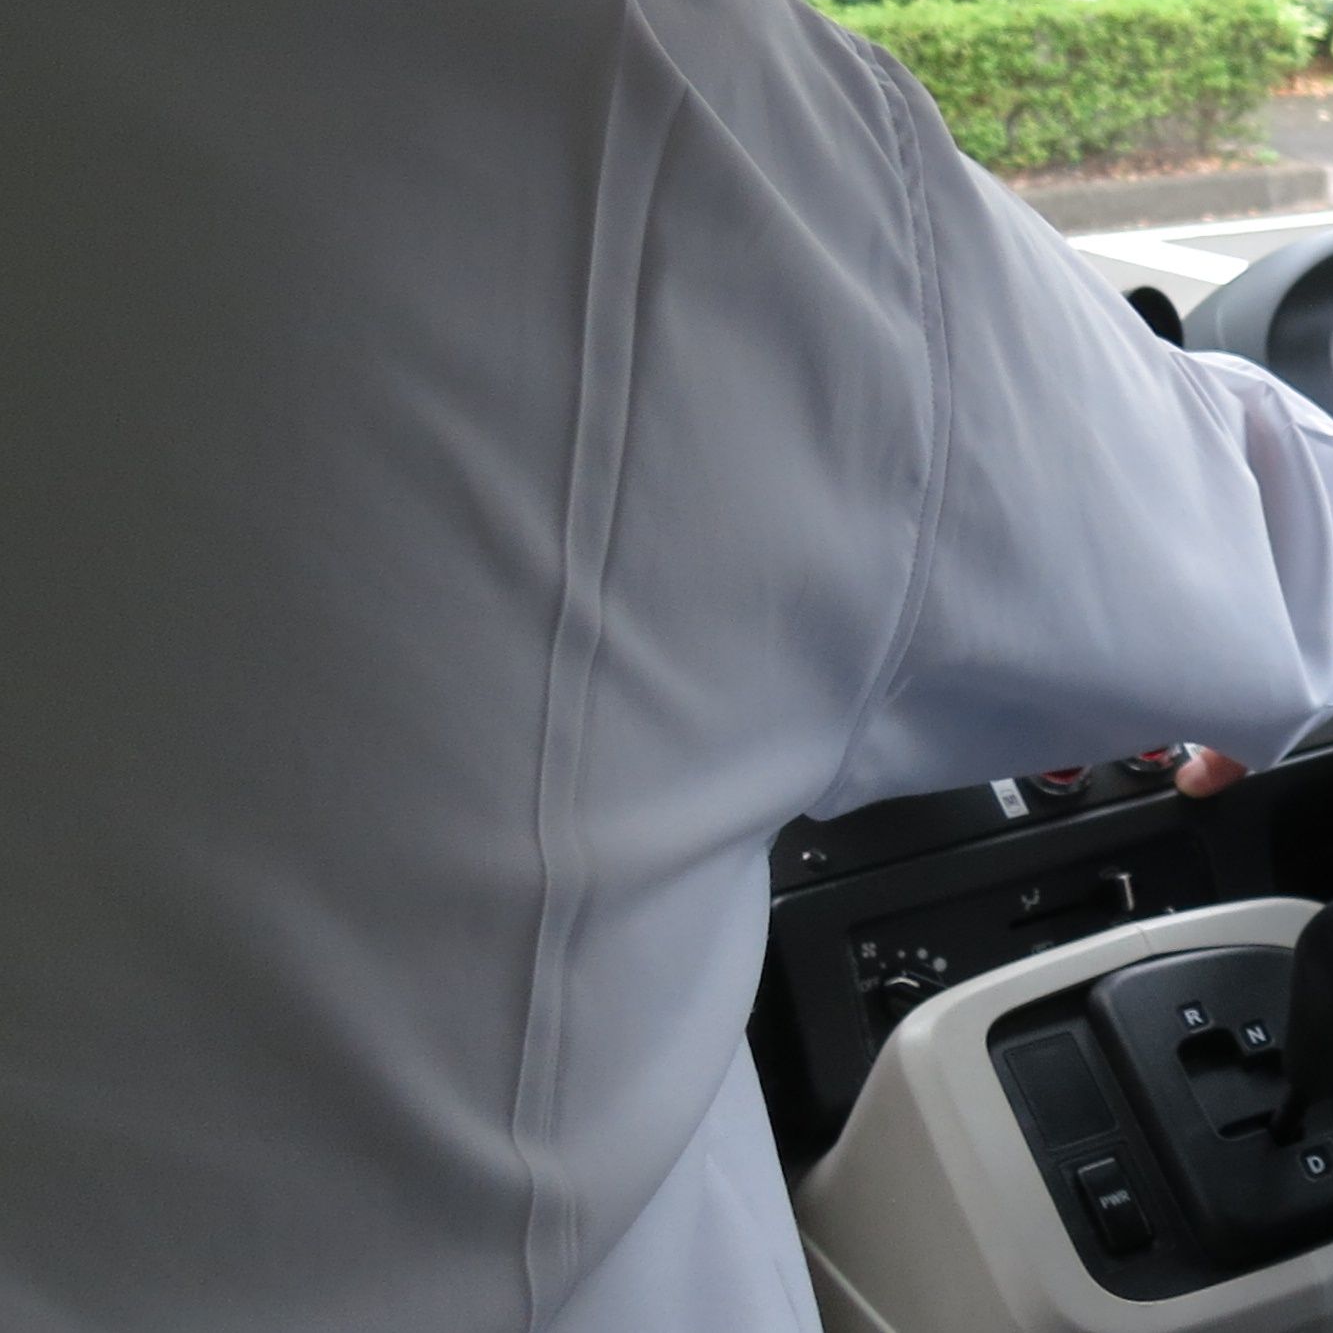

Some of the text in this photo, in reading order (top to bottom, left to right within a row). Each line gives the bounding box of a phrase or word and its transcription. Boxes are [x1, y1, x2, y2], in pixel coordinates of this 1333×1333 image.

[1182, 1006, 1202, 1027] R
[1245, 1024, 1267, 1045] N
[1306, 1154, 1325, 1175] D
[1100, 1189, 1131, 1209] PWR
